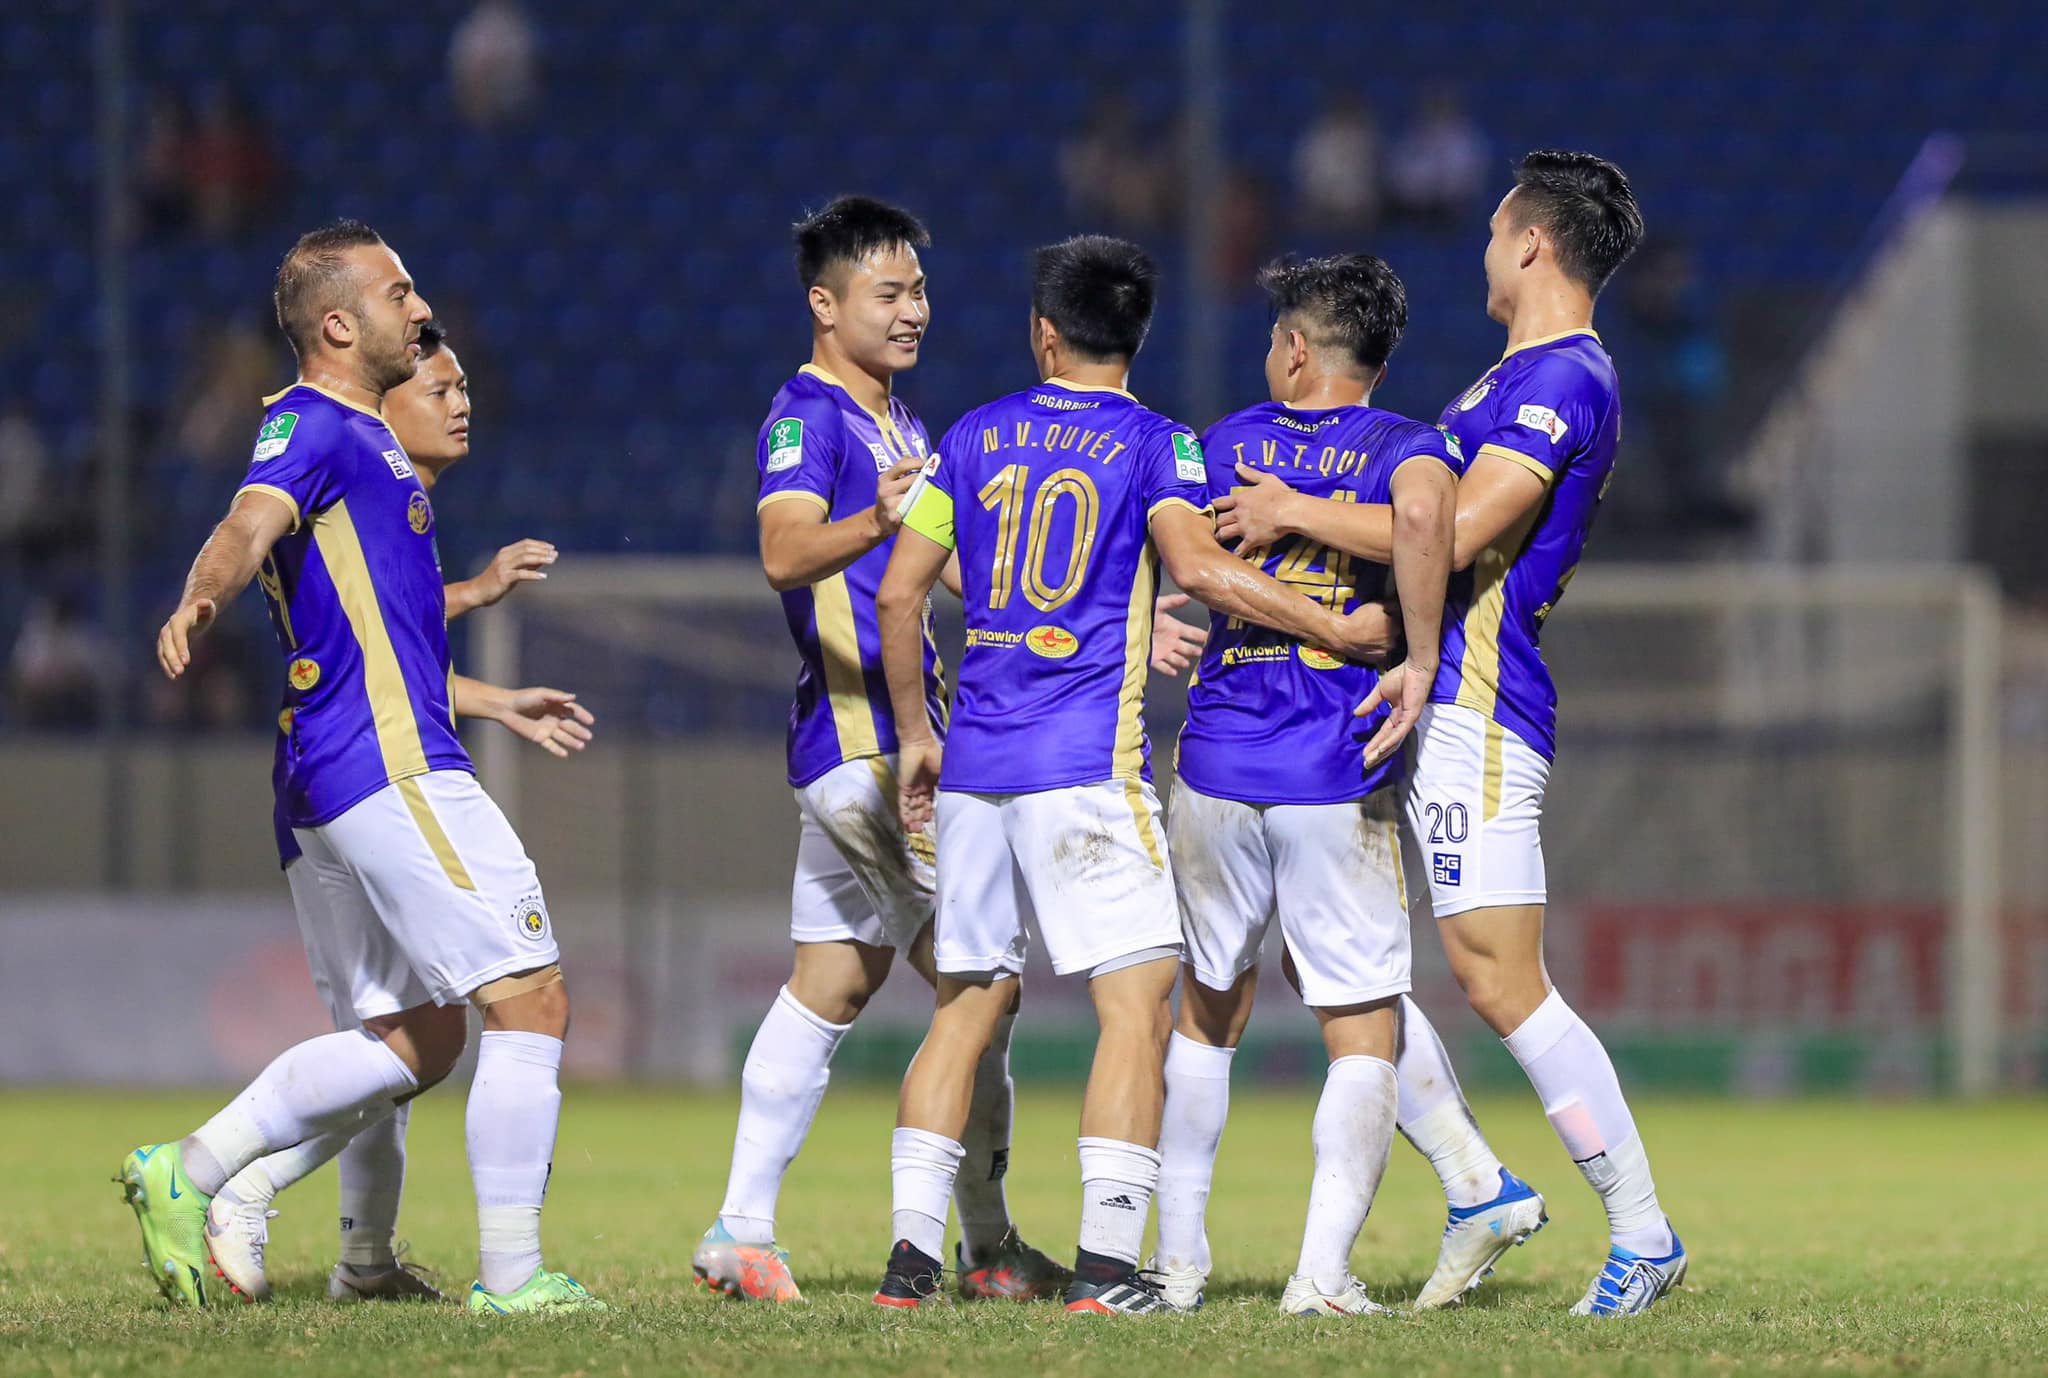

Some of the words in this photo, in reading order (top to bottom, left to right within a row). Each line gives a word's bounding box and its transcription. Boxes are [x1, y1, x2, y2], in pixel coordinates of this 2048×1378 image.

[1031, 393, 1100, 411] JOGARBOLA
[1272, 416, 1339, 433] JOGARBLA
[977, 464, 1099, 612] 10
[1235, 643, 1289, 658] Vinawnd
[1424, 802, 1469, 844] 20
[1099, 1200, 1137, 1211] adidas
